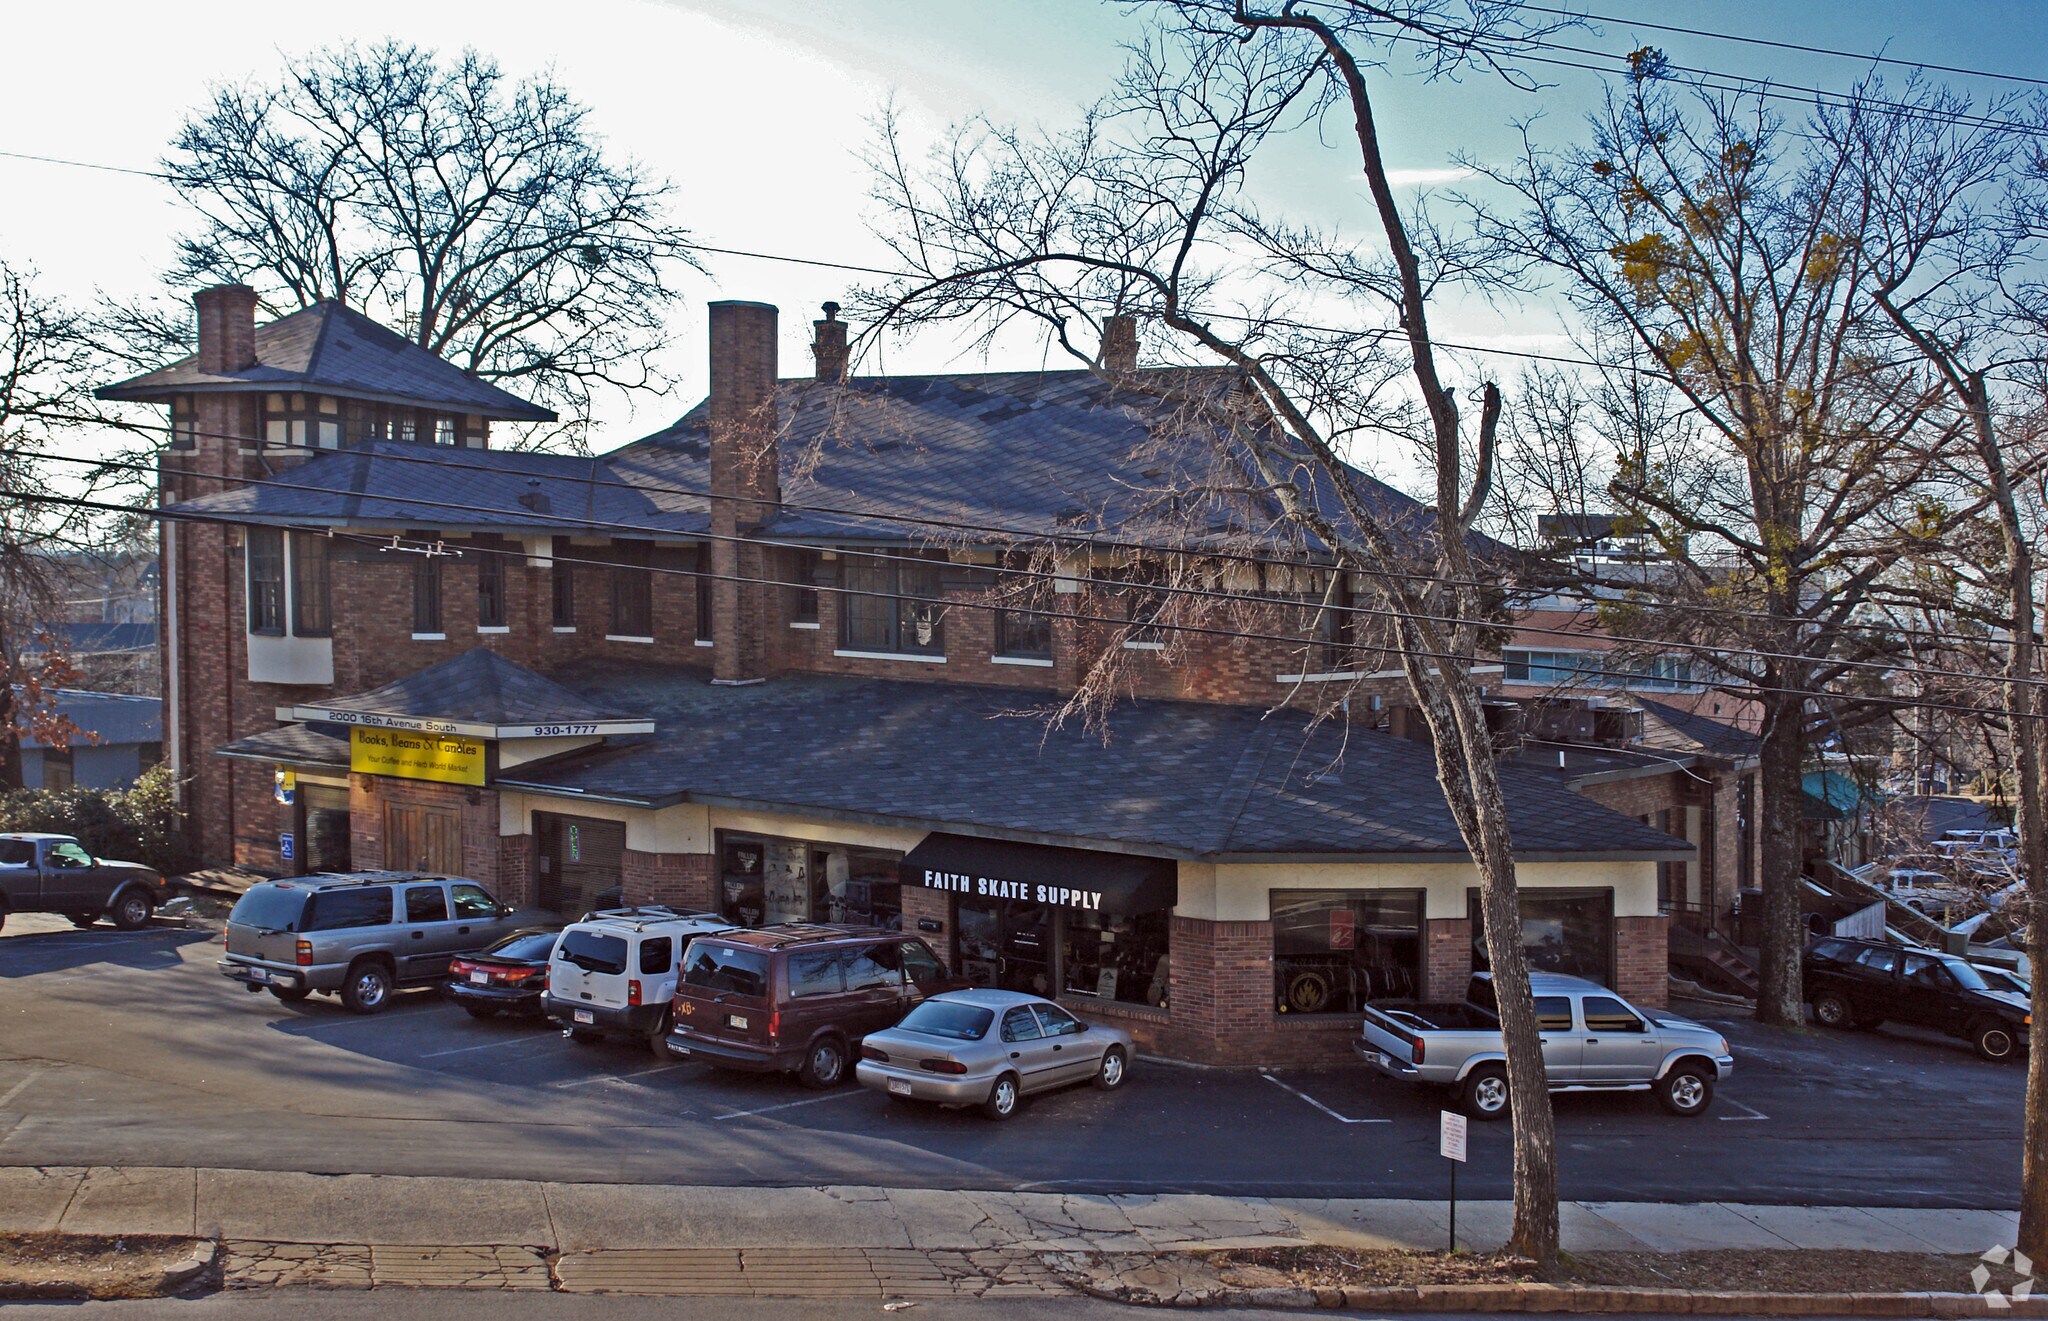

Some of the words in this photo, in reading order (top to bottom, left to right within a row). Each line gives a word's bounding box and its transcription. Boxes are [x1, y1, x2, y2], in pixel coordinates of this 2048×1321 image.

[329, 711, 357, 722] 2000
[361, 715, 383, 725] 16th
[385, 718, 422, 730] Avenue
[426, 721, 457, 732] South
[534, 725, 598, 736] 930-1777
[358, 729, 389, 748] Books,
[391, 733, 421, 750] Beans
[423, 737, 434, 751] &
[436, 738, 477, 756] Candles
[367, 755, 380, 763] Your
[381, 755, 400, 765] Coffee
[401, 758, 412, 767] and
[413, 760, 428, 769] Herb
[429, 761, 447, 771] World
[447, 763, 468, 773] Market
[924, 869, 970, 893] FAITH
[977, 877, 1029, 900] SKATE
[1036, 884, 1102, 911] SUPPLY
